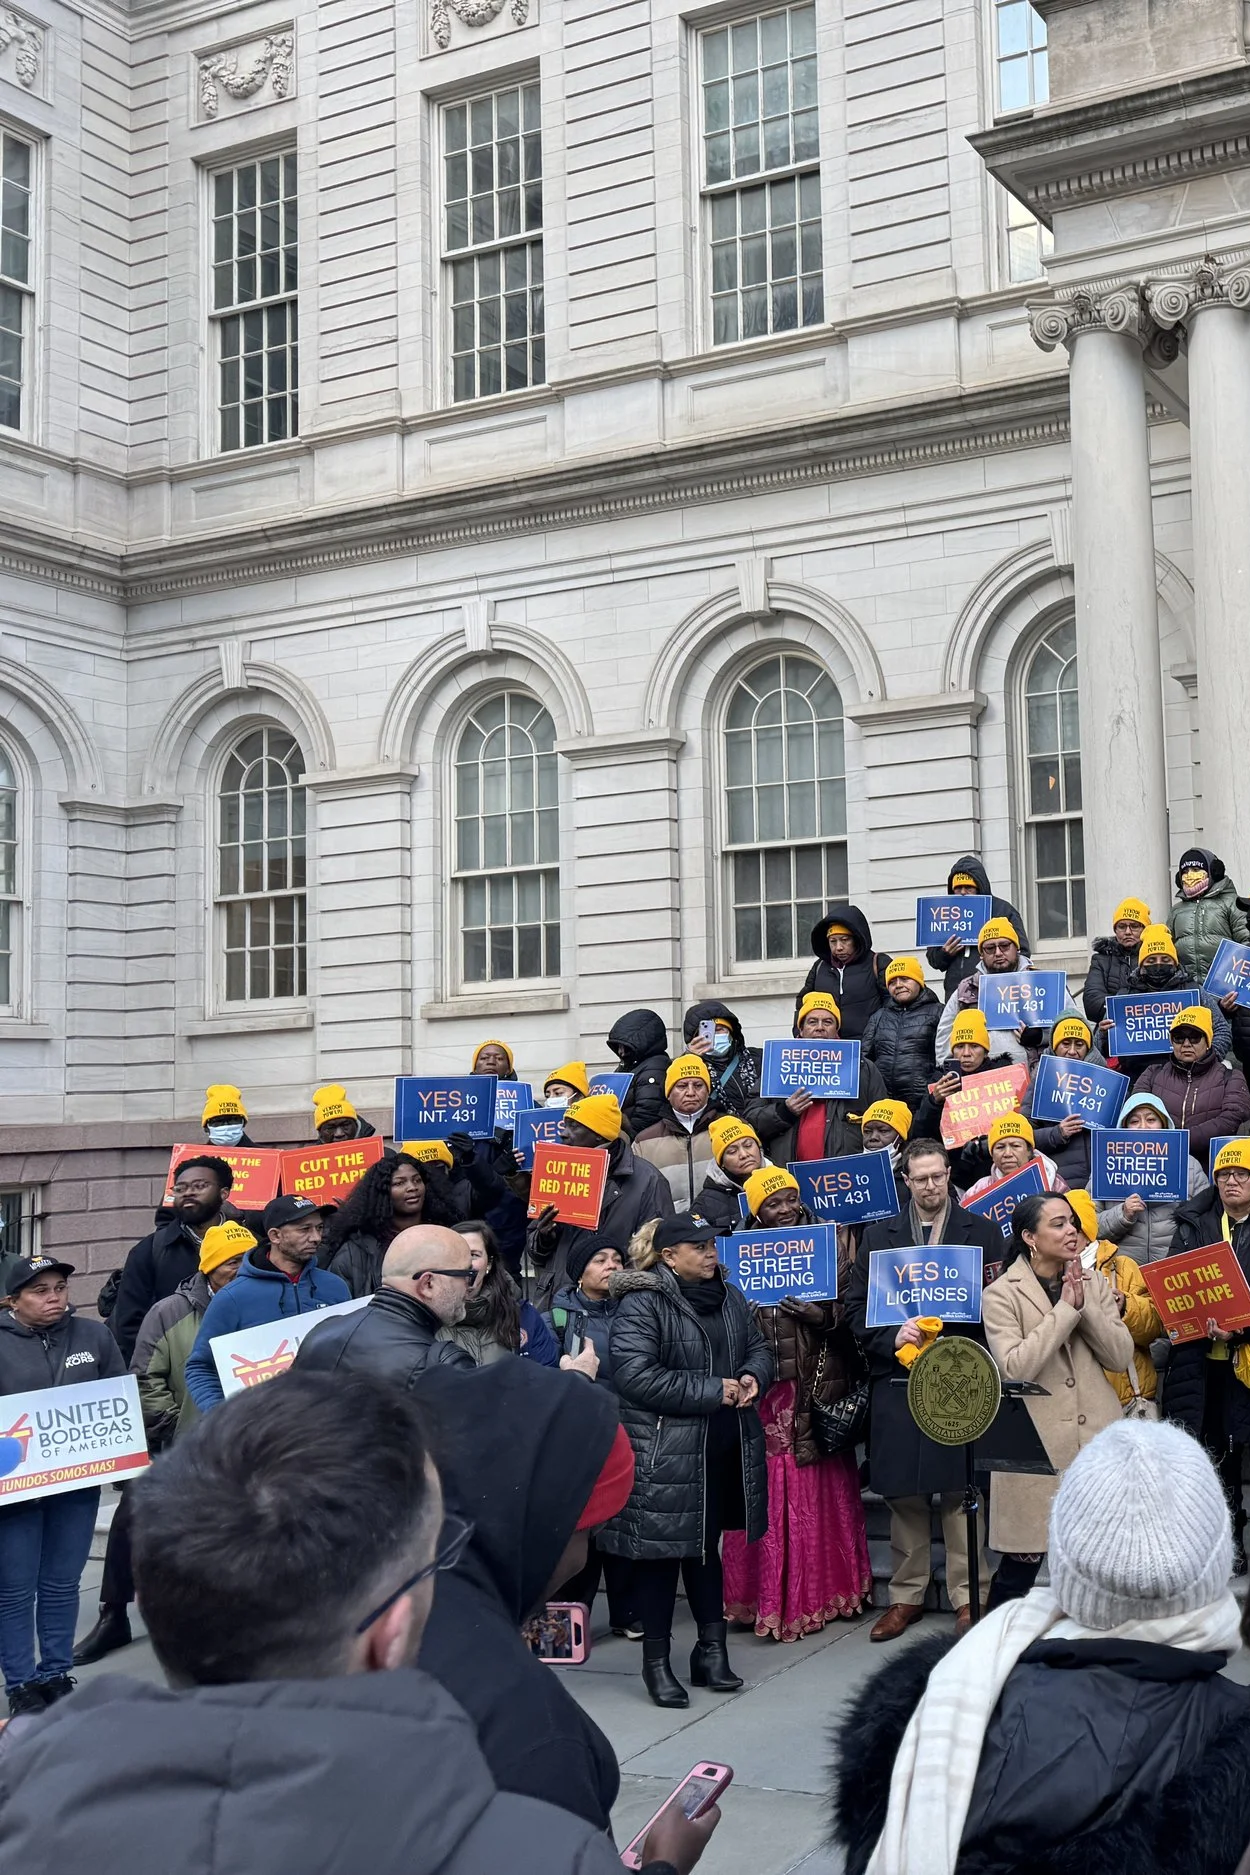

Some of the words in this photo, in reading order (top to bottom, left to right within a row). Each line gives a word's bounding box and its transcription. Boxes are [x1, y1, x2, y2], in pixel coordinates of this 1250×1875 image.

[931, 907, 960, 919] YES
[964, 909, 973, 918] to
[931, 922, 950, 932] INT.
[953, 922, 971, 931] 431
[1224, 972, 1244, 988] INT.
[997, 984, 1031, 1000] YES
[1035, 986, 1045, 996] to
[997, 1002, 1020, 1014] INT.
[1023, 1001, 1044, 1012] 431
[1125, 1002, 1183, 1016] REFORM
[1126, 1030, 1171, 1042] VENDIN
[782, 1050, 842, 1061] REFORM
[781, 1061, 841, 1074] STREET
[780, 1074, 840, 1085] VENDING
[1055, 1072, 1092, 1094] YES
[1096, 1084, 1106, 1097] to
[418, 1091, 462, 1108] YES
[466, 1094, 478, 1105] to
[951, 1090, 980, 1105] CUT
[982, 1080, 1013, 1096] THE
[1052, 1090, 1074, 1106] INT.
[1078, 1098, 1102, 1112] 431
[419, 1111, 447, 1123] INT.
[452, 1110, 476, 1122] 431
[949, 1108, 978, 1124] RED
[982, 1096, 1020, 1116] TAPE
[1106, 1142, 1168, 1155] REFORM
[241, 1158, 261, 1166] THE
[300, 1158, 329, 1173] CUT
[332, 1152, 364, 1166] THE
[546, 1161, 566, 1175] CUT
[571, 1163, 591, 1178] THE
[1106, 1157, 1168, 1171] STREET
[295, 1177, 325, 1191] RED
[809, 1172, 852, 1193] YES
[856, 1174, 869, 1185] to
[1106, 1173, 1167, 1185] VENDING
[540, 1180, 560, 1193] RED
[564, 1182, 589, 1197] TAPE
[814, 1194, 841, 1209] INT.
[845, 1189, 871, 1204] 431
[983, 1196, 1015, 1221] YES
[739, 1239, 814, 1258] REFORM
[739, 1255, 814, 1276] STREET
[894, 1262, 939, 1284] YES
[944, 1266, 958, 1278] to
[739, 1272, 814, 1291] VENDING
[1163, 1272, 1192, 1292] CUT
[1193, 1263, 1223, 1284] THE
[887, 1288, 968, 1305] LICENSES
[1166, 1295, 1194, 1313] RED
[1196, 1284, 1234, 1305] TAPE
[65, 1356, 95, 1368] KORS
[36, 1397, 128, 1430] UNITED
[39, 1418, 131, 1448] BODEGAS
[42, 1447, 60, 1458] OF
[69, 1435, 133, 1454] AMERICA
[50, 1465, 87, 1482] SOMOS
[89, 1460, 116, 1474] MAS!
